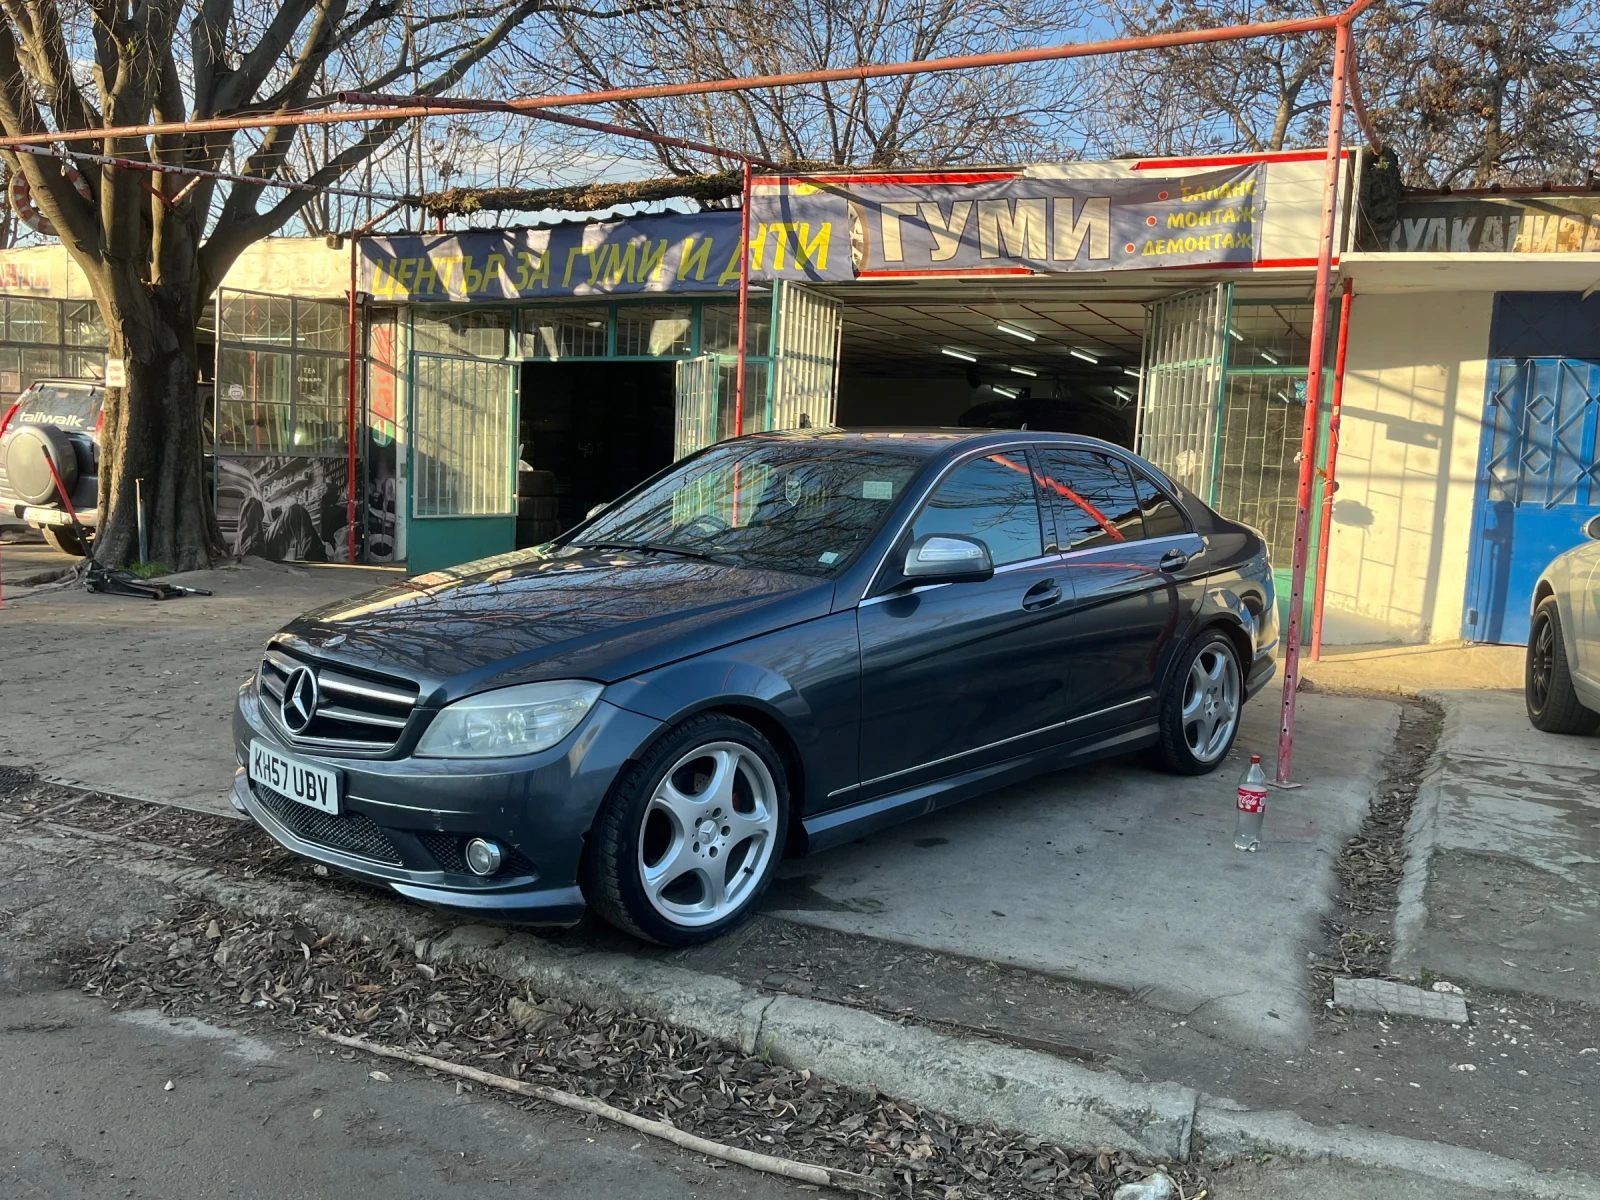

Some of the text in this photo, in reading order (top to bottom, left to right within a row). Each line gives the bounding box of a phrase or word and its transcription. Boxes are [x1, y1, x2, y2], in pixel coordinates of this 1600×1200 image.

[1180, 179, 1258, 203] БАЛАНС
[880, 197, 1112, 262] ГУМИ
[1167, 206, 1256, 229] МОНТАЖ
[1141, 232, 1254, 256] ДЕМОНТАЖ
[371, 253, 506, 301] ЦЕНТЪР
[509, 249, 550, 292] ЗА
[561, 238, 668, 288] ГУМИ
[676, 237, 714, 281] И
[20, 411, 84, 427] tailwalk
[254, 747, 328, 806] KH57 UBV
